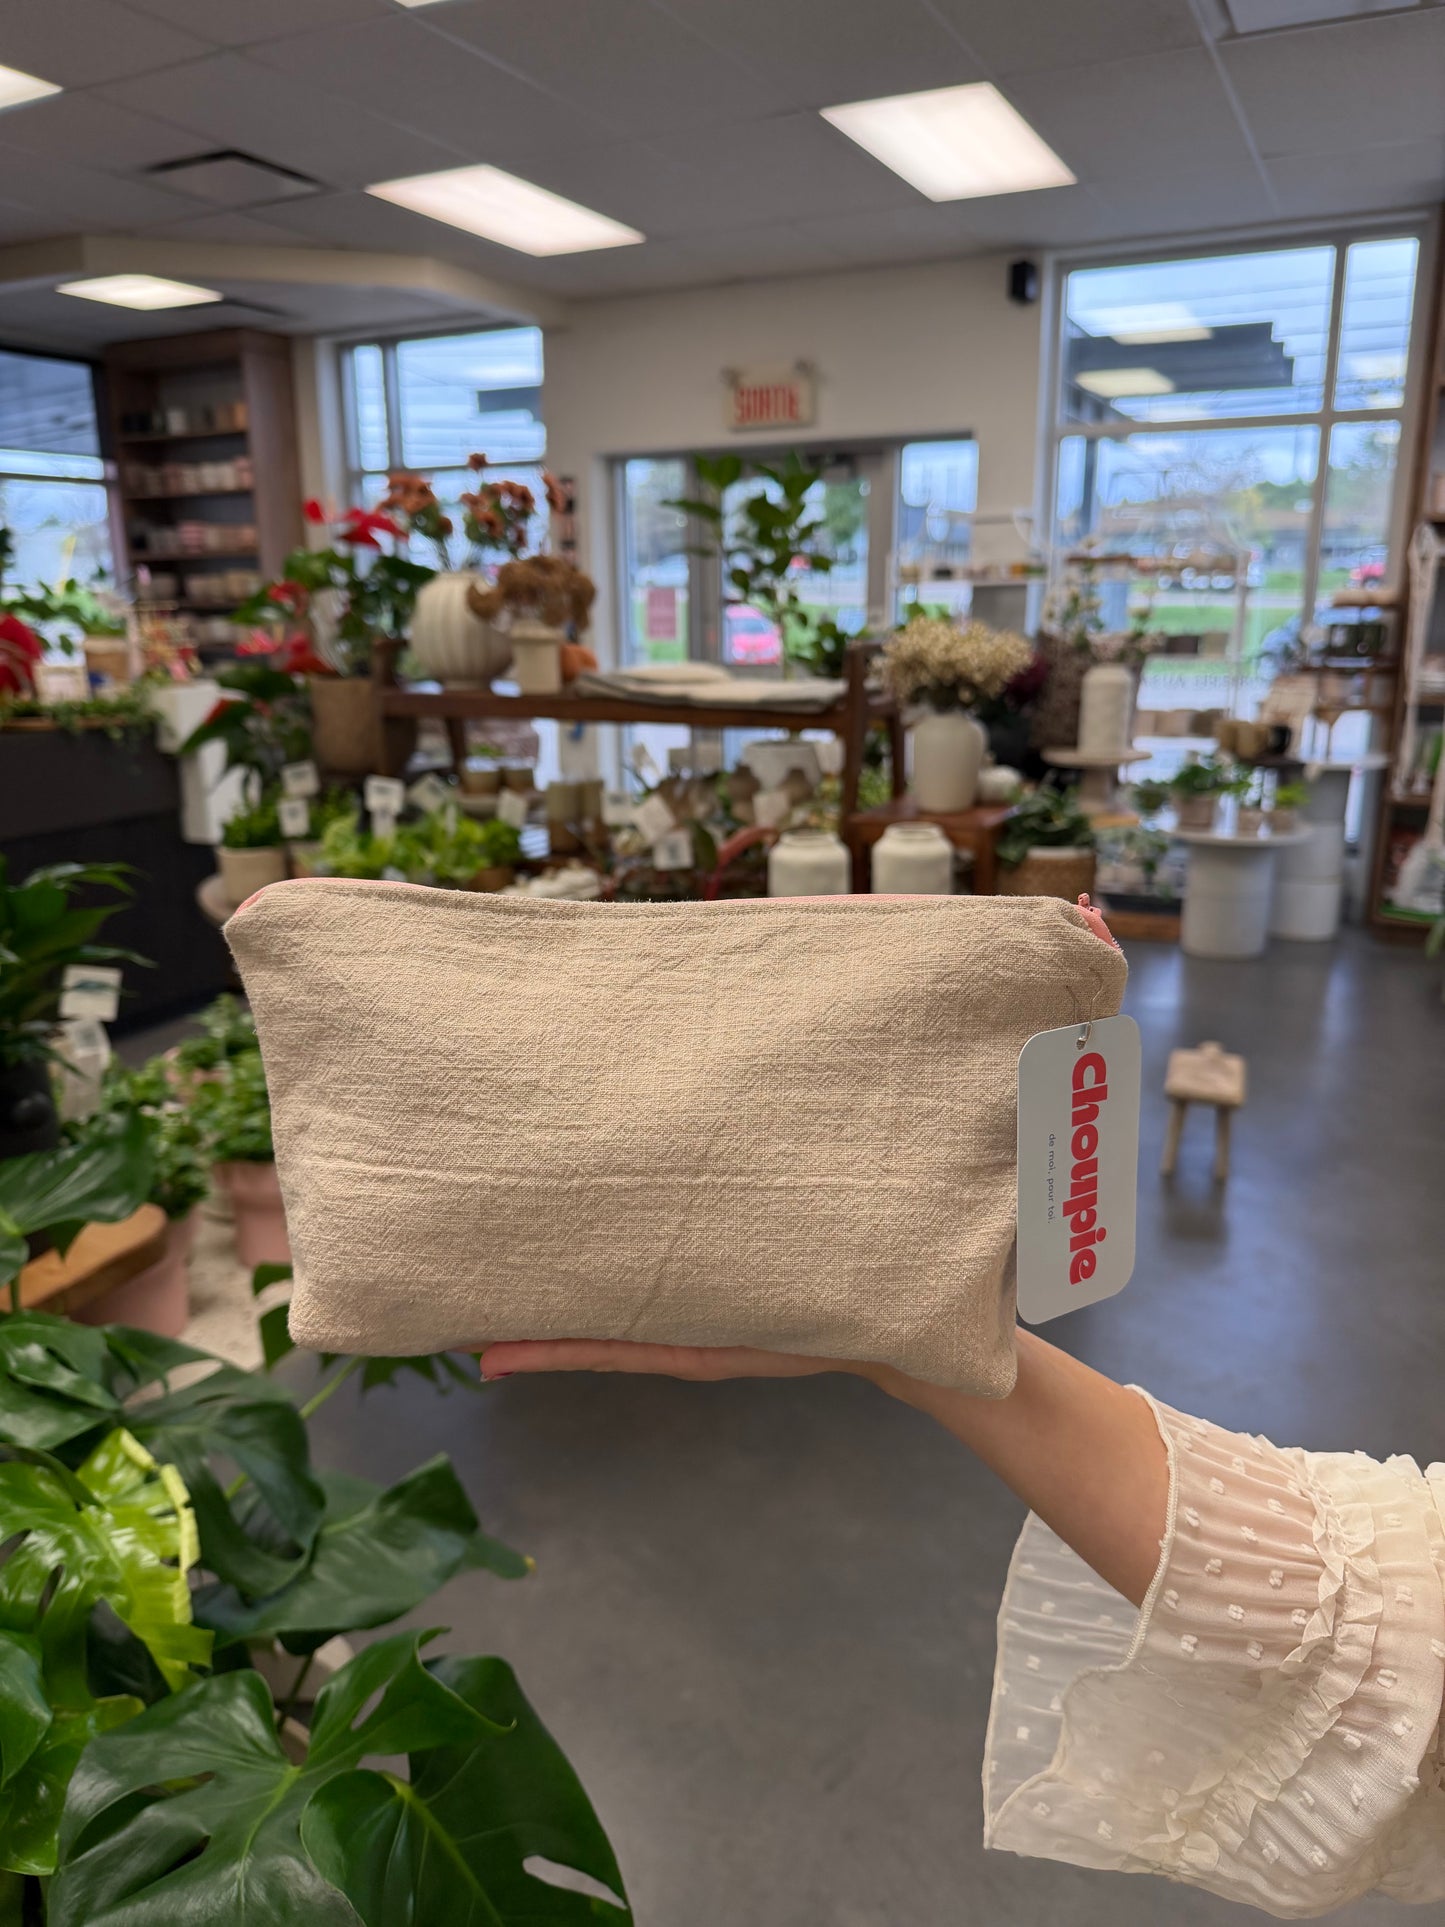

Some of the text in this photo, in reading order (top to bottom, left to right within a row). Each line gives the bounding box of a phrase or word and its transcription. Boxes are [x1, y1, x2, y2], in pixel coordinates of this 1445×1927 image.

[734, 385, 800, 423] SORTIE
[1048, 1133, 1056, 1147] de
[1063, 1052, 1107, 1284] Choupie
[1046, 1178, 1055, 1201] pour
[1047, 1205, 1055, 1224] toi.
